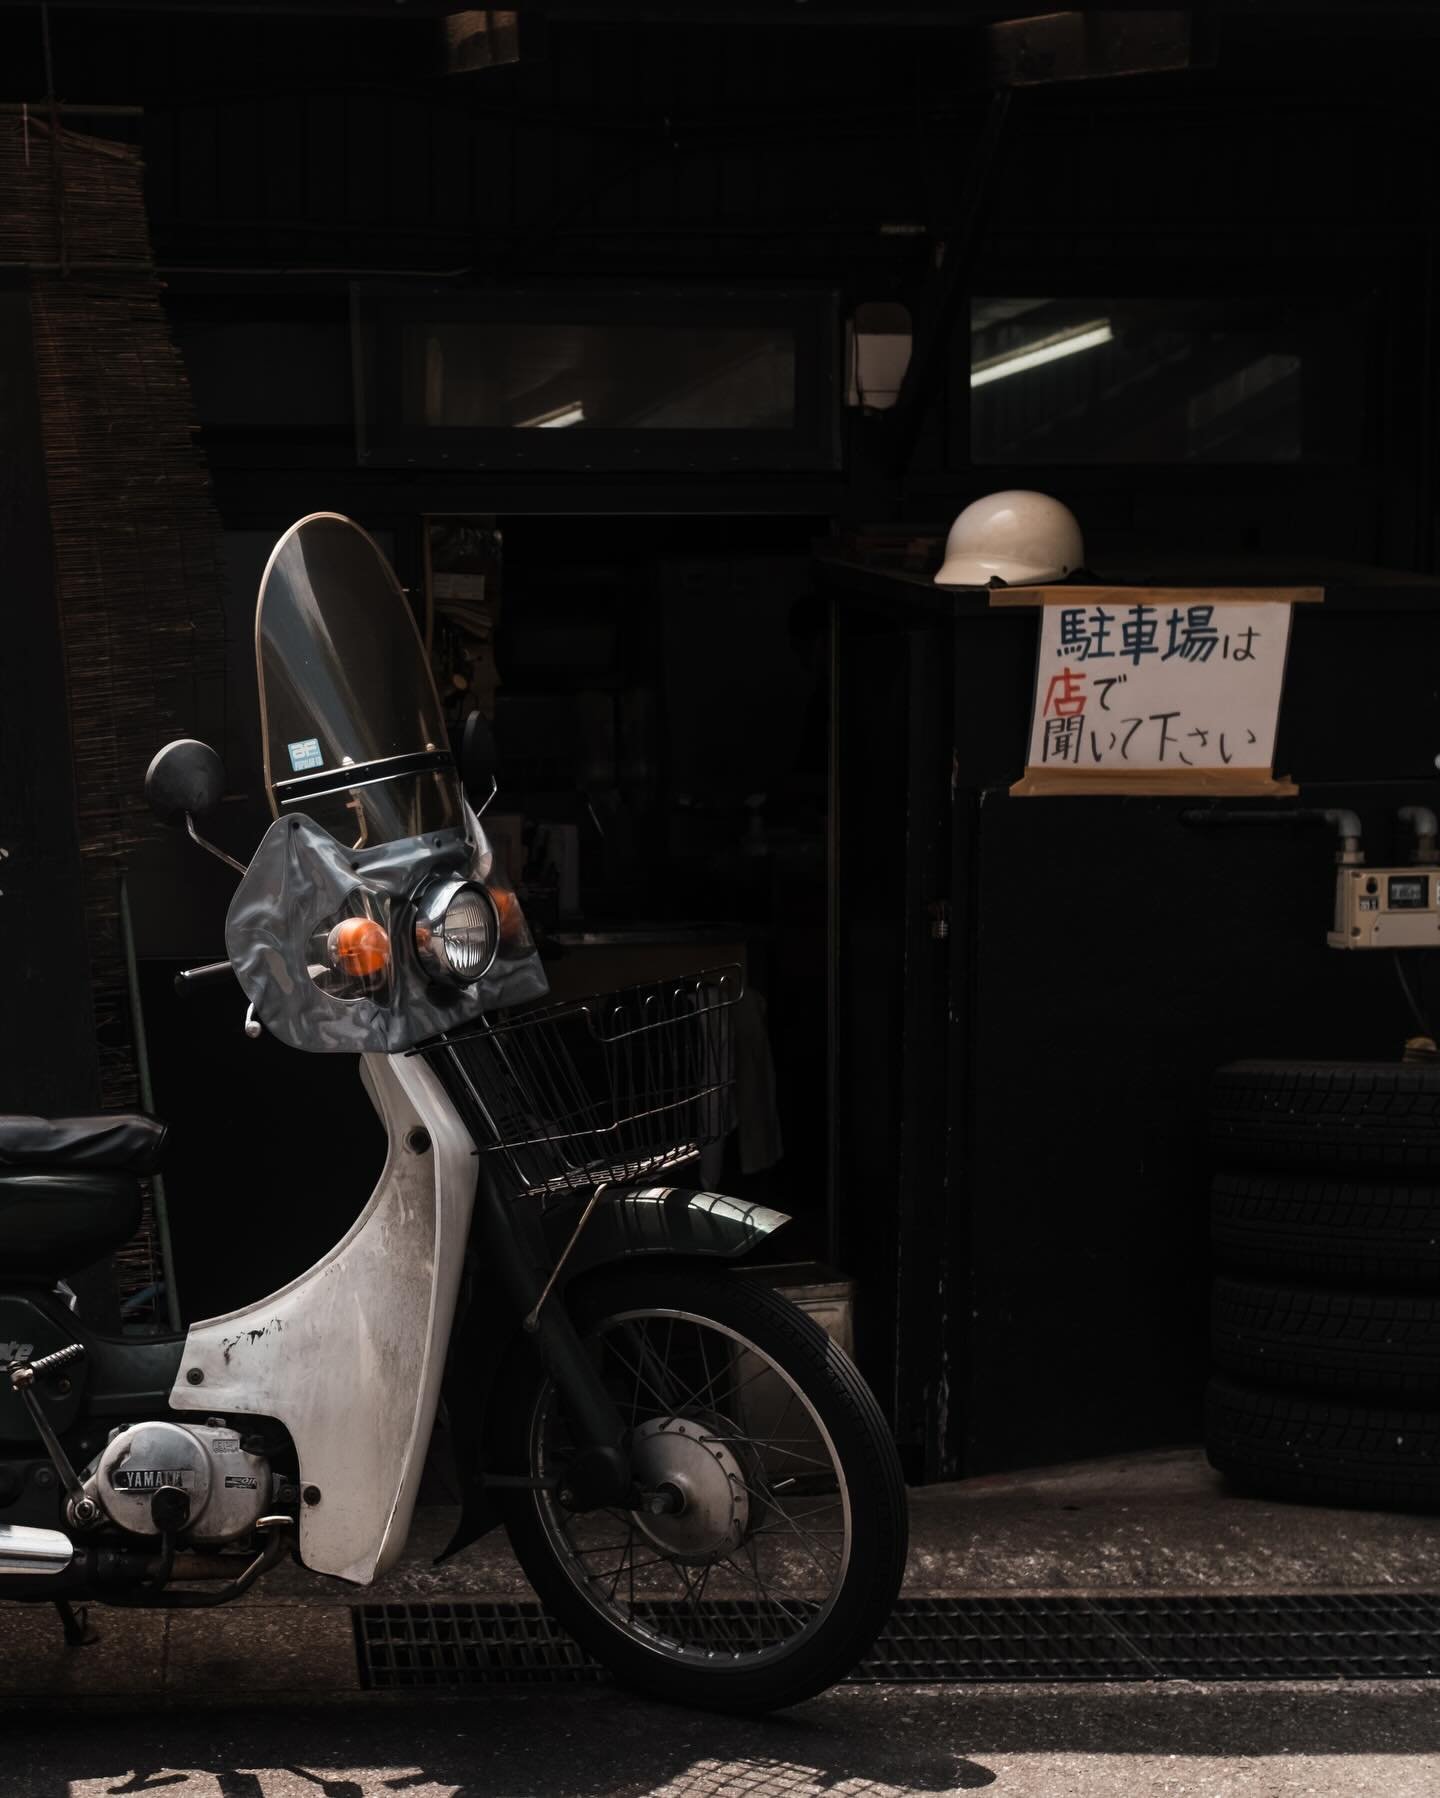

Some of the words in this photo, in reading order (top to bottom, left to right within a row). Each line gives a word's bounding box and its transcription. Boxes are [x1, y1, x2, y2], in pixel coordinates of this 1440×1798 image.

[1057, 604, 1261, 666] 駐車場は
[1043, 667, 1127, 717] 店で
[1042, 712, 1256, 765] 聞いて下さい
